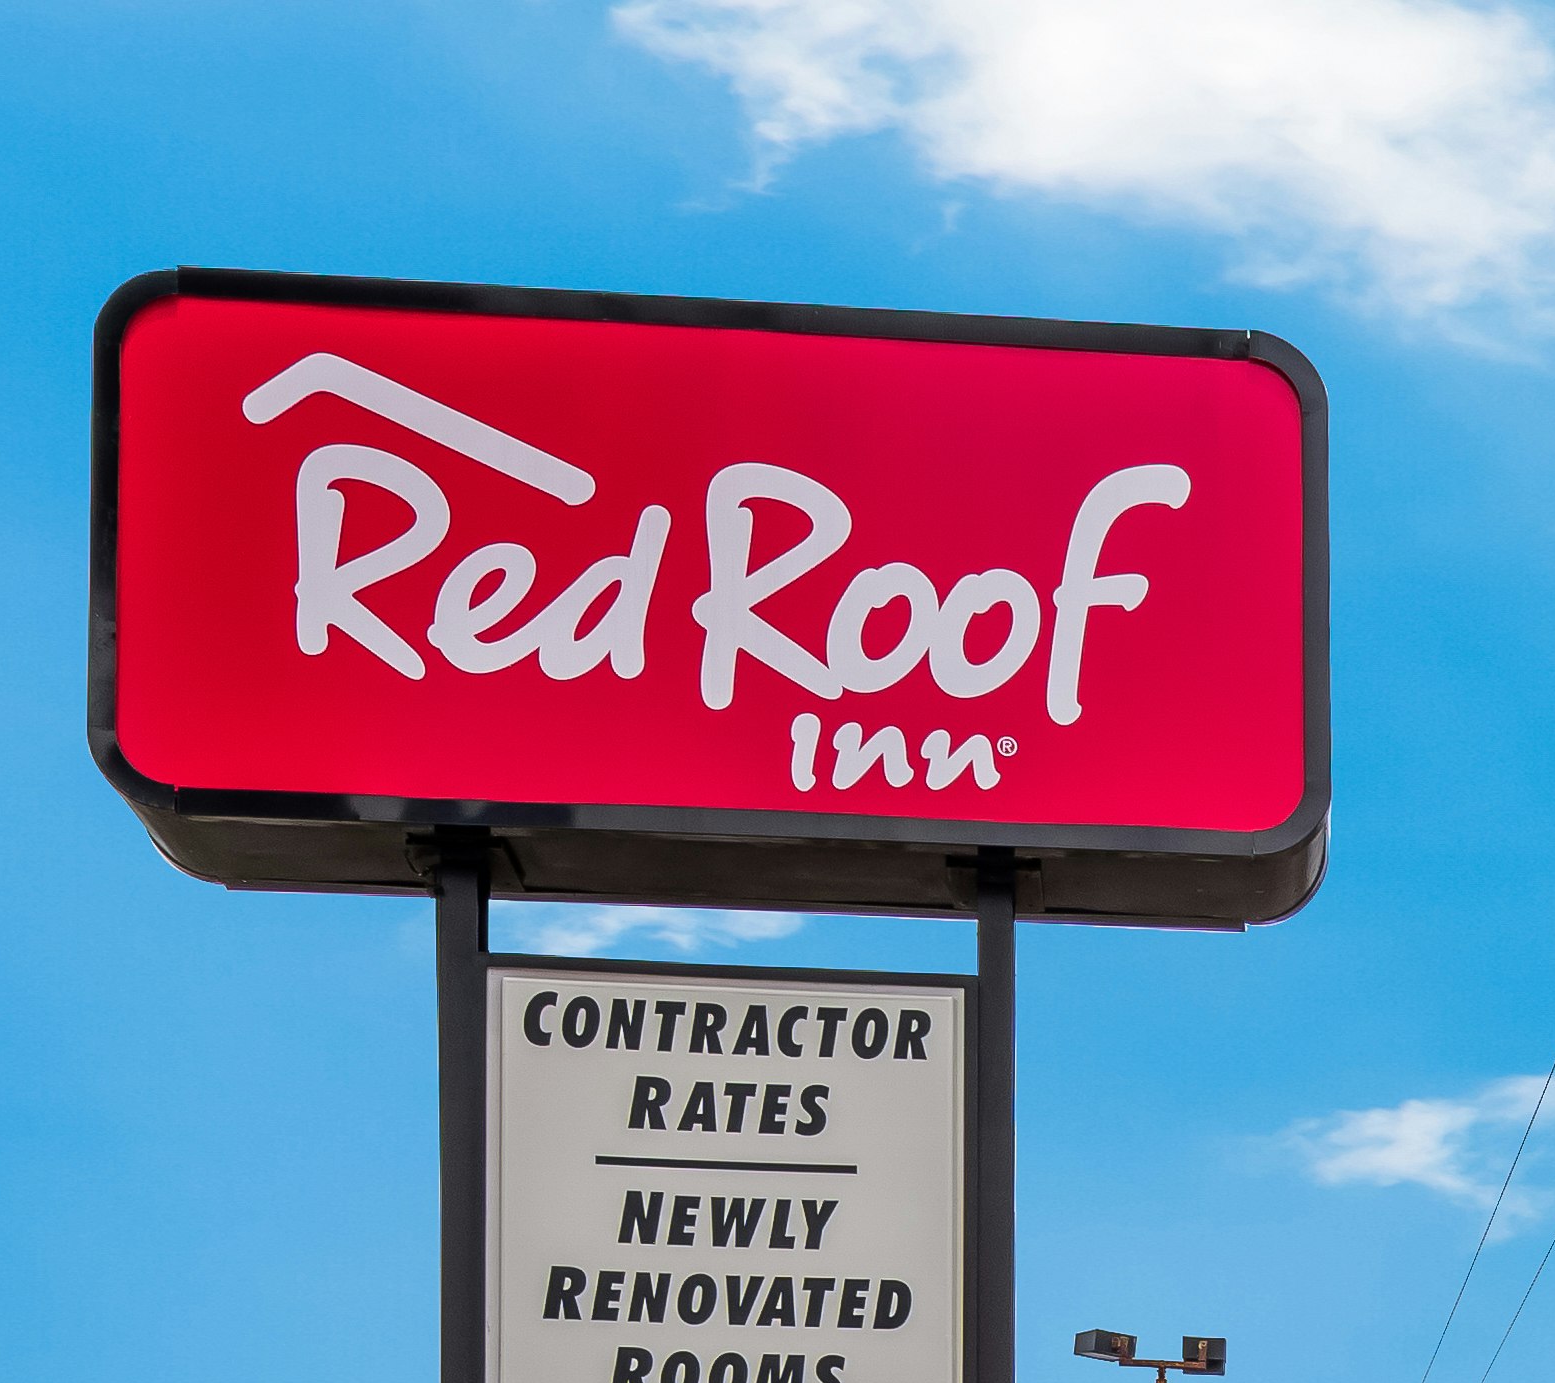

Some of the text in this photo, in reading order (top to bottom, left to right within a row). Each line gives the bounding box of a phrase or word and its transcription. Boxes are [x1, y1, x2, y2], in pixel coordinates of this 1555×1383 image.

[294, 443, 1193, 726] Red Roof
[523, 991, 933, 1061] CONTRACTOR
[627, 1075, 831, 1137] RATES
[617, 1190, 840, 1251] NEWLY
[542, 1264, 913, 1331] RENOVATED
